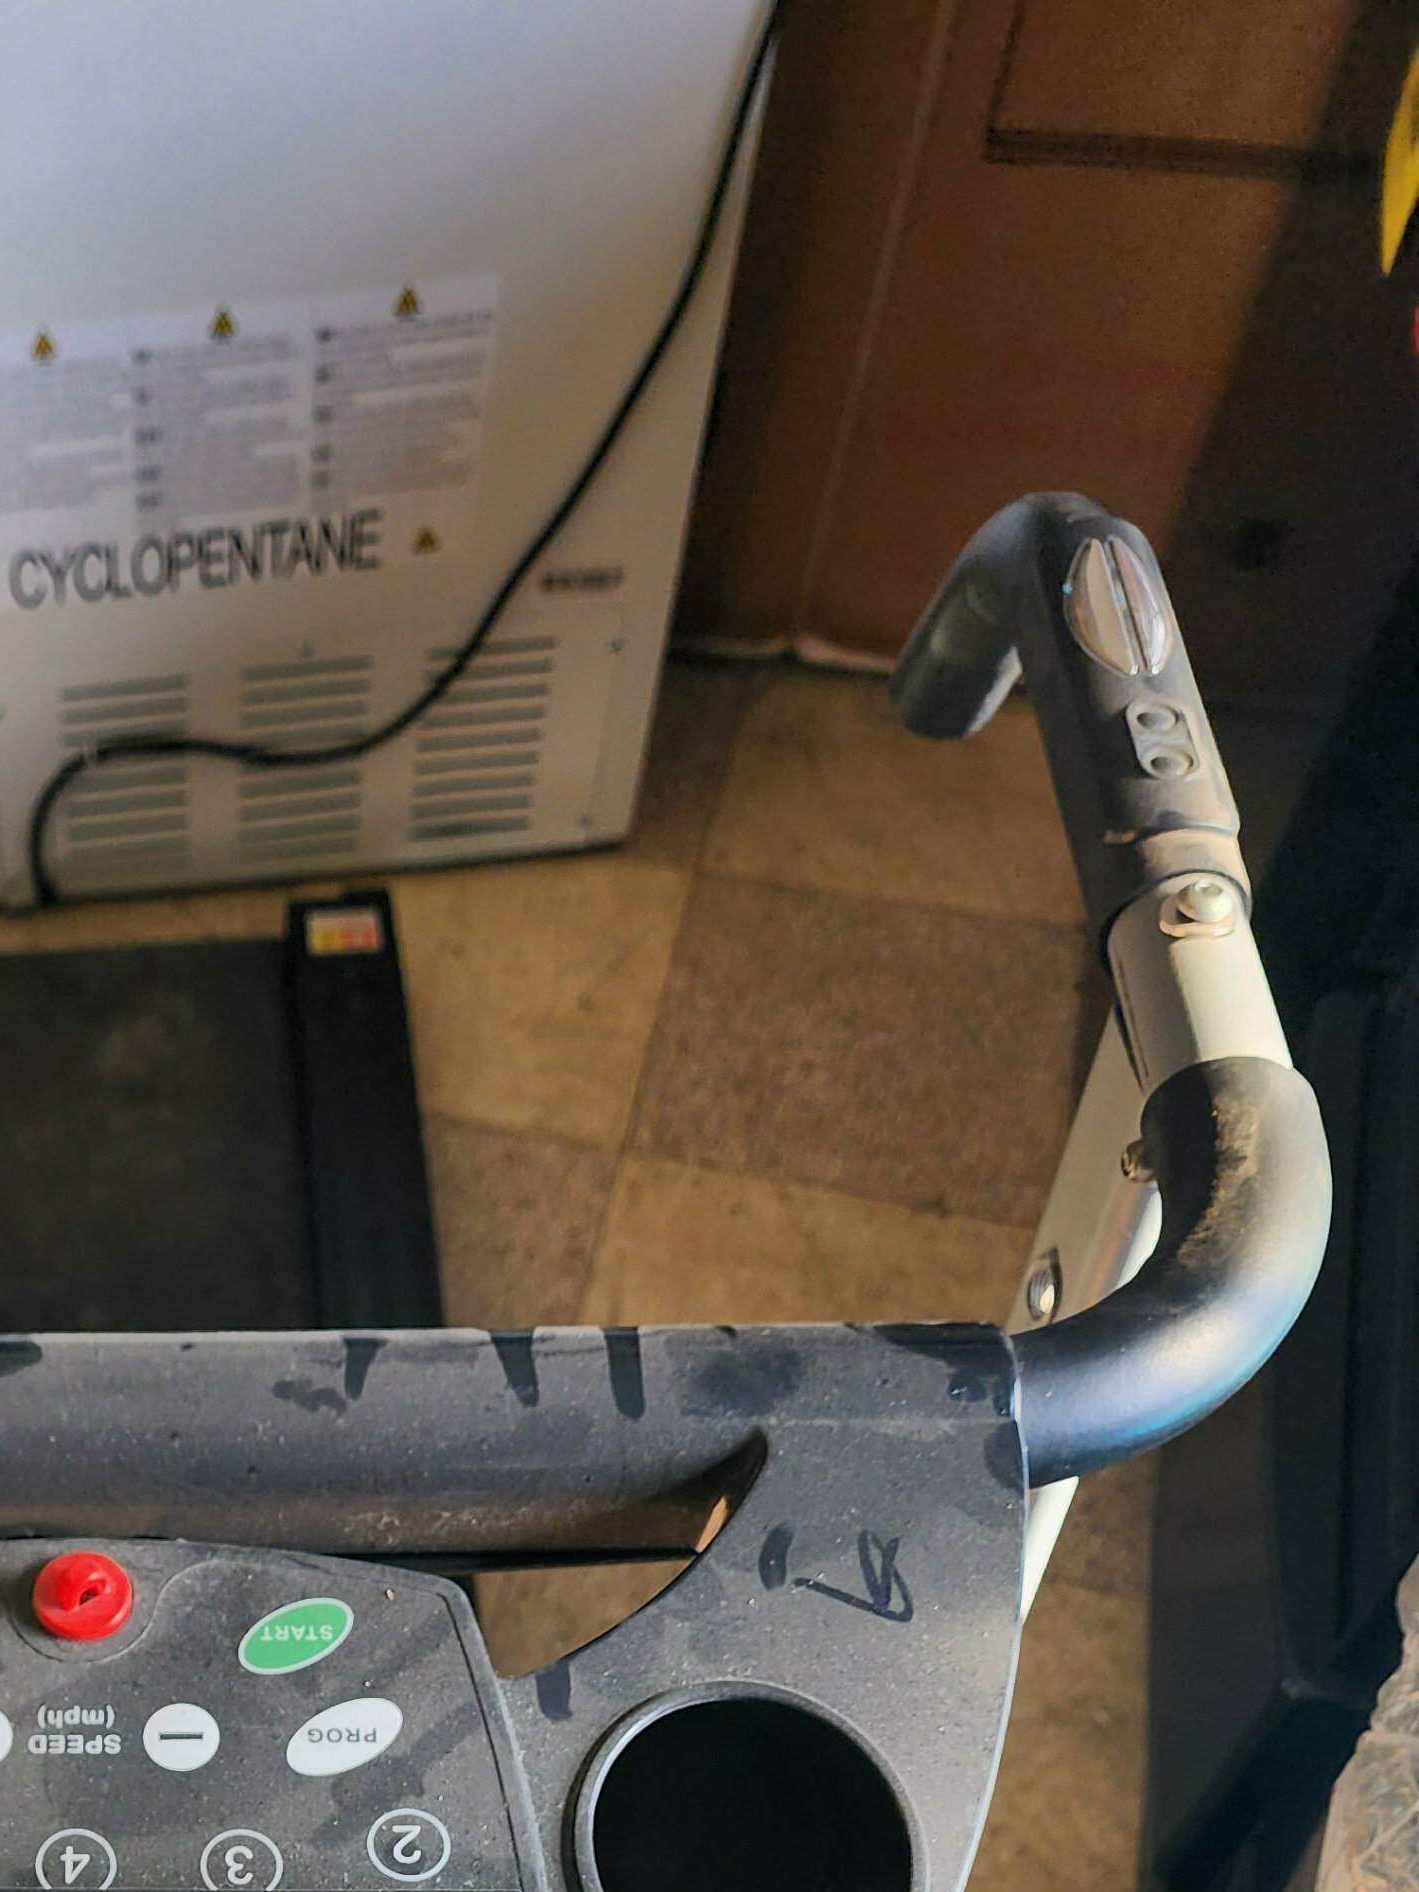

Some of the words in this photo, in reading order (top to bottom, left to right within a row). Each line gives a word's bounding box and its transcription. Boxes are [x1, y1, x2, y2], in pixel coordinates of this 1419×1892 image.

[8, 507, 383, 610] CYCLOPENTANE
[260, 1624, 333, 1642] START
[37, 1704, 115, 1729] (mph)
[28, 1734, 121, 1755] SPEED
[307, 1727, 377, 1744] PROG
[392, 1825, 422, 1864] 2
[60, 1845, 91, 1885] 4
[224, 1845, 254, 1885] 3
